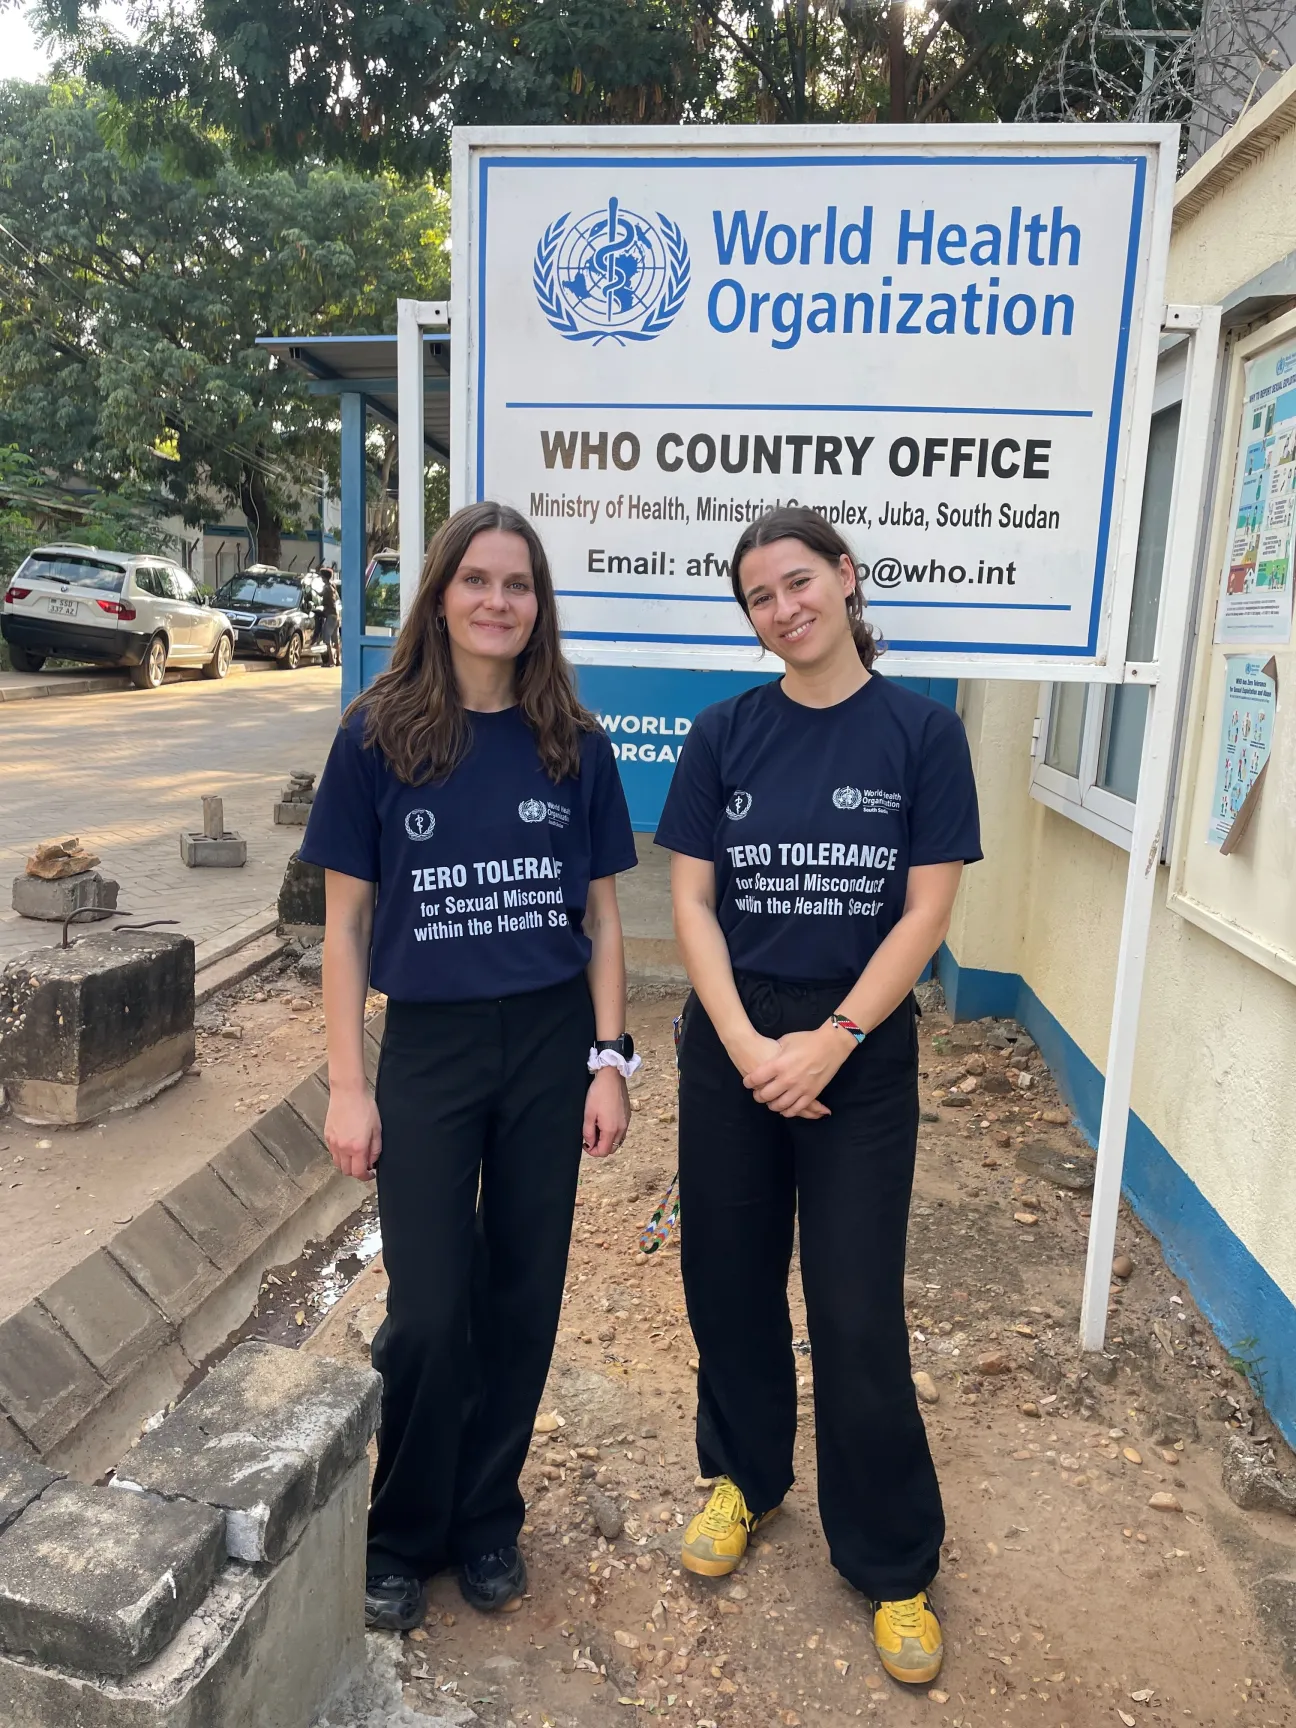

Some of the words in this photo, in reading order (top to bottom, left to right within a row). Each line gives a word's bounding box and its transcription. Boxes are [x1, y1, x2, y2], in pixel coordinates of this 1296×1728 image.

[712, 205, 873, 265] World
[897, 205, 1081, 266] Health
[707, 276, 1075, 350] Organization
[540, 431, 641, 471] WHO
[656, 432, 876, 476] COUNTRY
[888, 436, 1052, 479] OFFICE
[529, 492, 600, 524] Ministry
[605, 494, 624, 519] of
[628, 494, 690, 525] Health,
[878, 501, 930, 531] Juba,
[936, 501, 993, 527] South
[998, 503, 1061, 529] Sudan
[587, 548, 675, 576] Email:
[596, 714, 692, 736] WORLD
[863, 789, 883, 797] World
[778, 842, 898, 871] TOLERANCE
[411, 864, 467, 893] ZERO
[735, 877, 753, 891] for
[754, 872, 799, 892] Sexual
[804, 873, 885, 894] Misconduct
[420, 902, 440, 917] for
[445, 891, 498, 915] Sexual
[767, 897, 791, 914] the
[794, 896, 843, 916] Health
[413, 920, 463, 942] within
[468, 918, 493, 936] the
[497, 910, 543, 933] Health
